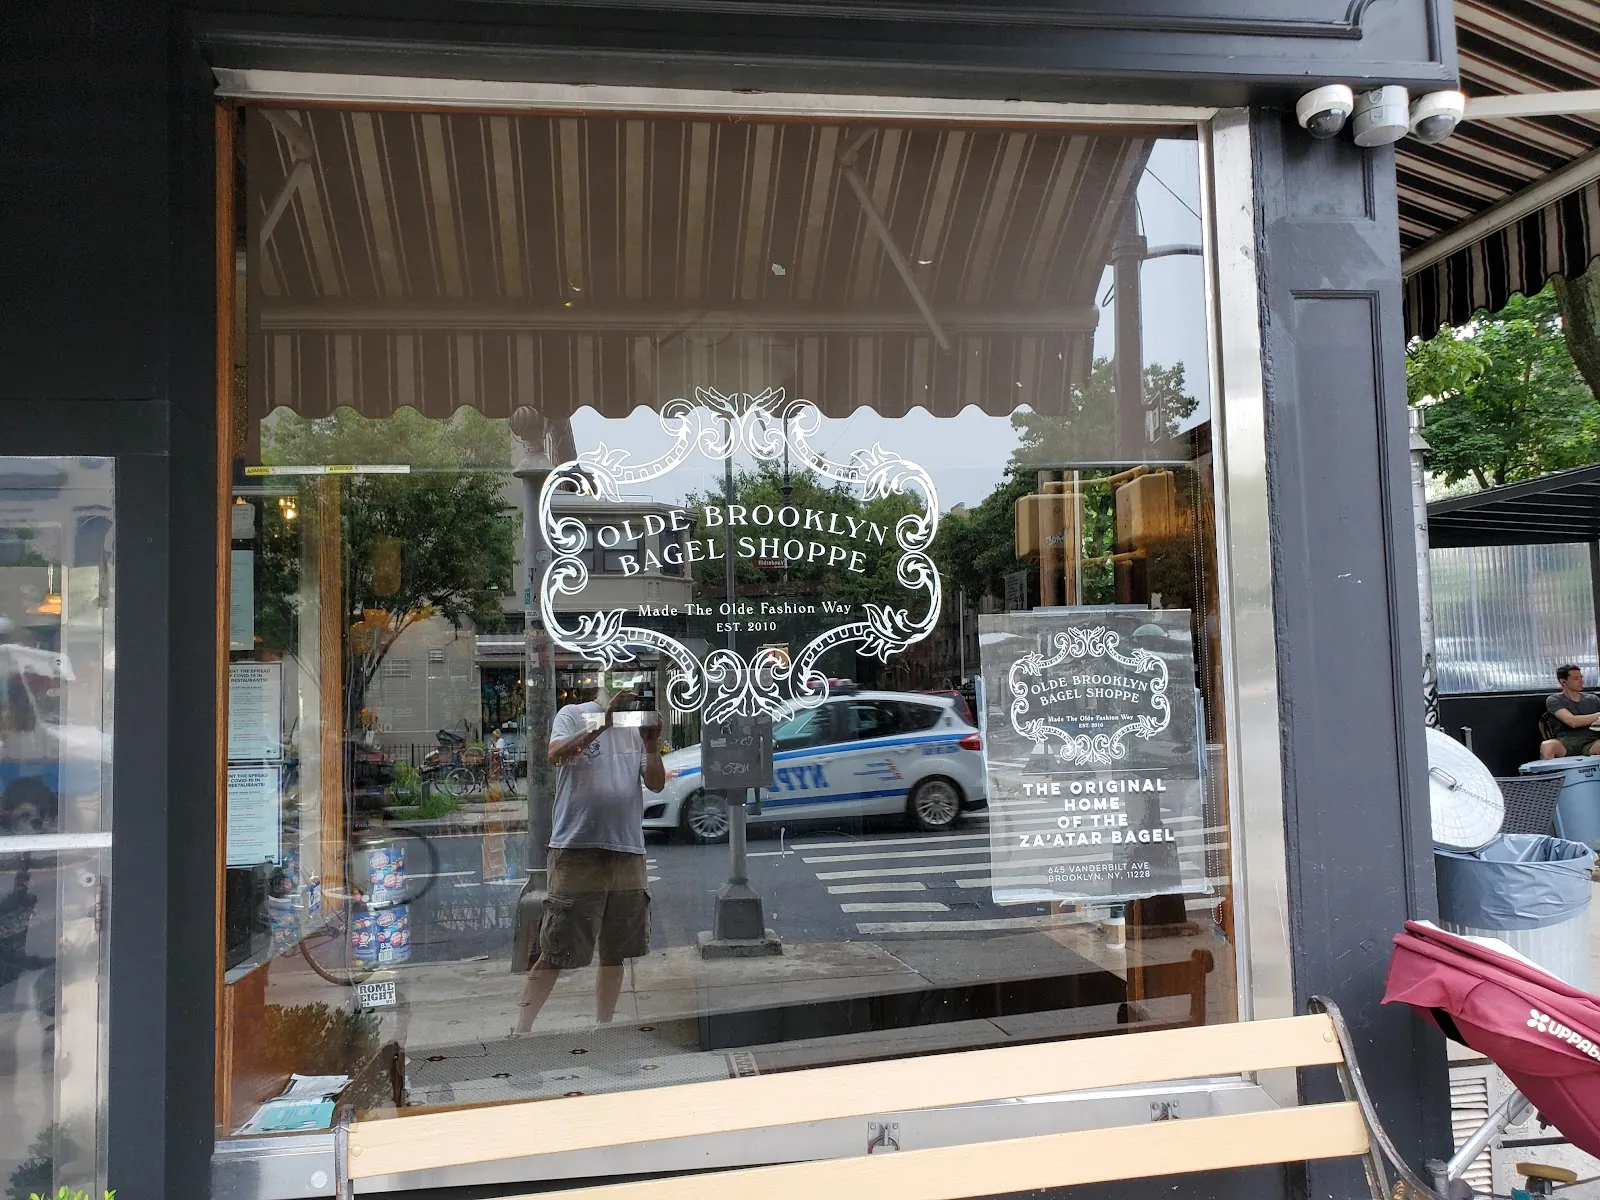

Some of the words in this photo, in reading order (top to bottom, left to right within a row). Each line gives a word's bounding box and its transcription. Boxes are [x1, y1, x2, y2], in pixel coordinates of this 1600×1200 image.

[597, 508, 691, 548] OLDE
[705, 504, 889, 547] BROOKLYN
[618, 536, 726, 577] BAGEL
[737, 536, 868, 574] SHOPPE
[638, 604, 678, 617] Made
[684, 603, 713, 616] The
[719, 602, 754, 615] Olde
[760, 601, 815, 615] Fashion
[822, 600, 851, 615] Way
[716, 622, 743, 633] EST.
[748, 621, 777, 632] 2010
[1031, 677, 1067, 695] OLDE
[1072, 674, 1149, 692] BROOKLYN
[1040, 687, 1082, 707] BAGEL
[1086, 687, 1140, 703] SHOPPE
[1048, 715, 1064, 723] Made
[1079, 714, 1094, 722] Olde
[1096, 714, 1119, 722] Fashion
[1120, 714, 1134, 722] Way
[1023, 782, 1061, 797] THE
[1069, 779, 1167, 795] ORIGINAL
[1064, 797, 1120, 811] HOME
[1057, 815, 1082, 829] OF
[1090, 813, 1128, 828] THE
[1111, 828, 1175, 844] BAGEL
[1048, 866, 1066, 874] 645
[1068, 863, 1129, 873] VANDERBILT
[1131, 862, 1149, 871] AVE
[1048, 873, 1104, 883] BROOKLYN,
[1126, 870, 1151, 879] 11228
